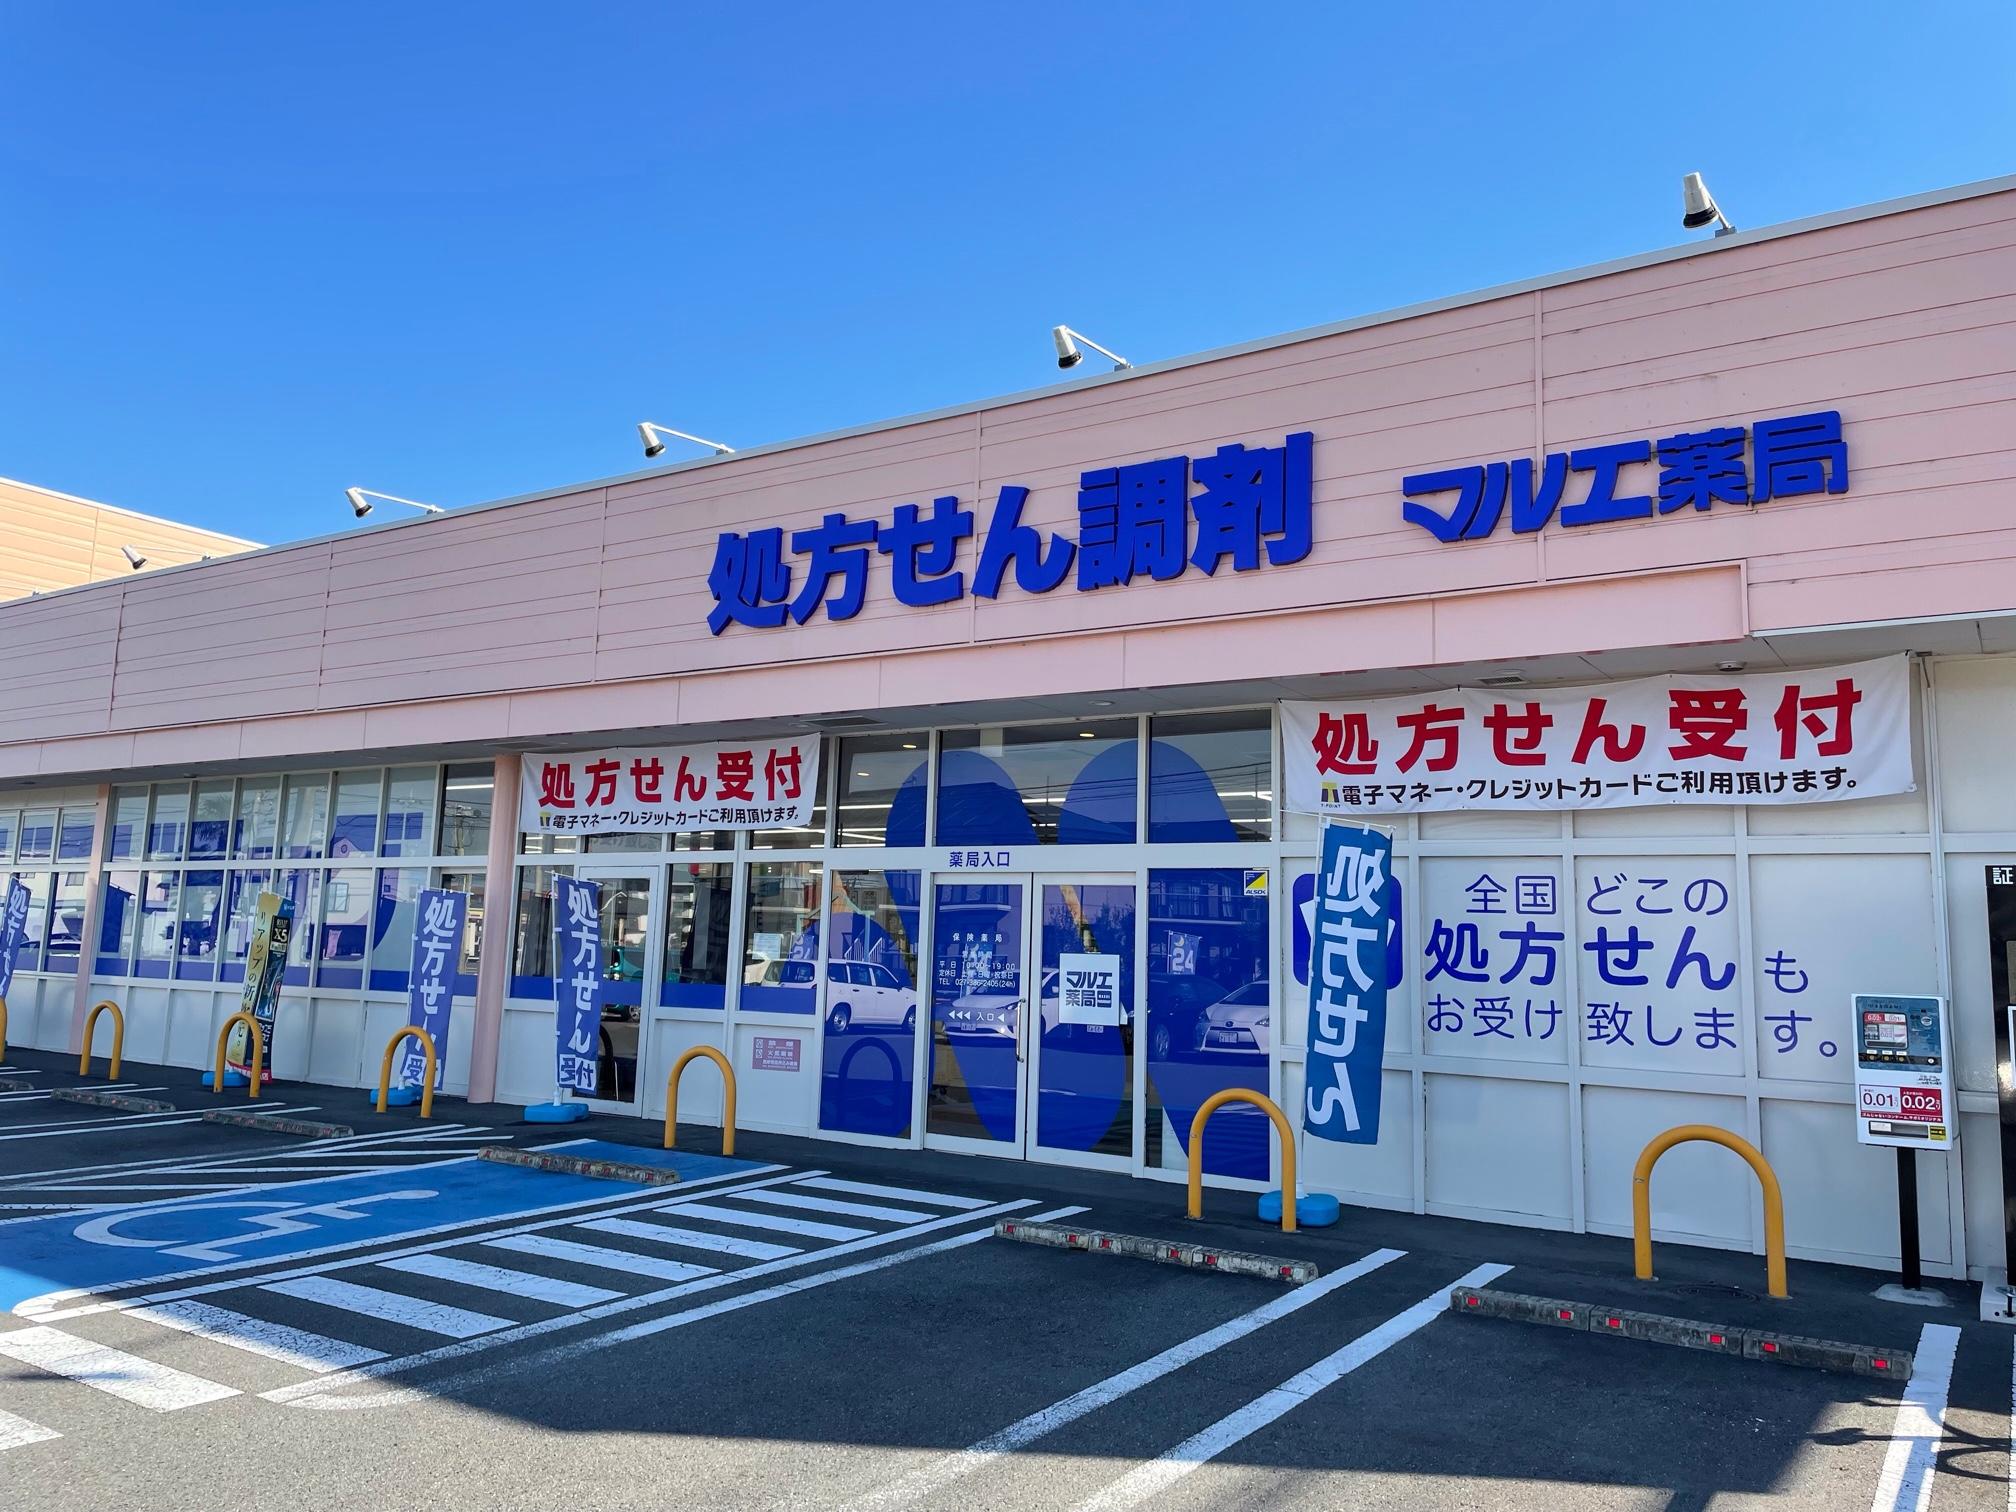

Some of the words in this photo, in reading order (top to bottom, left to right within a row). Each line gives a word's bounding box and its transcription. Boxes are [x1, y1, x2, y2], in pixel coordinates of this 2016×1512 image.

[1402, 410, 1849, 543] マルエ薬局
[707, 431, 1314, 636] 処方せん調剤
[1312, 678, 1862, 776] 処方せん受付
[538, 746, 802, 808] 処方せん受付
[1342, 766, 1857, 806] 電子マネー・クレジットカードご利用頂けます。
[949, 851, 1010, 868] 薬局入口
[1992, 867, 2014, 885] 証
[274, 927, 288, 942] X5
[568, 884, 599, 1054] 処方せん
[1066, 971, 1113, 990] マルエ
[1065, 989, 1096, 1008] 薬局
[976, 1012, 995, 1021] 入口
[1863, 1092, 1893, 1107] 0.01
[1902, 1095, 1936, 1110] 0.02
